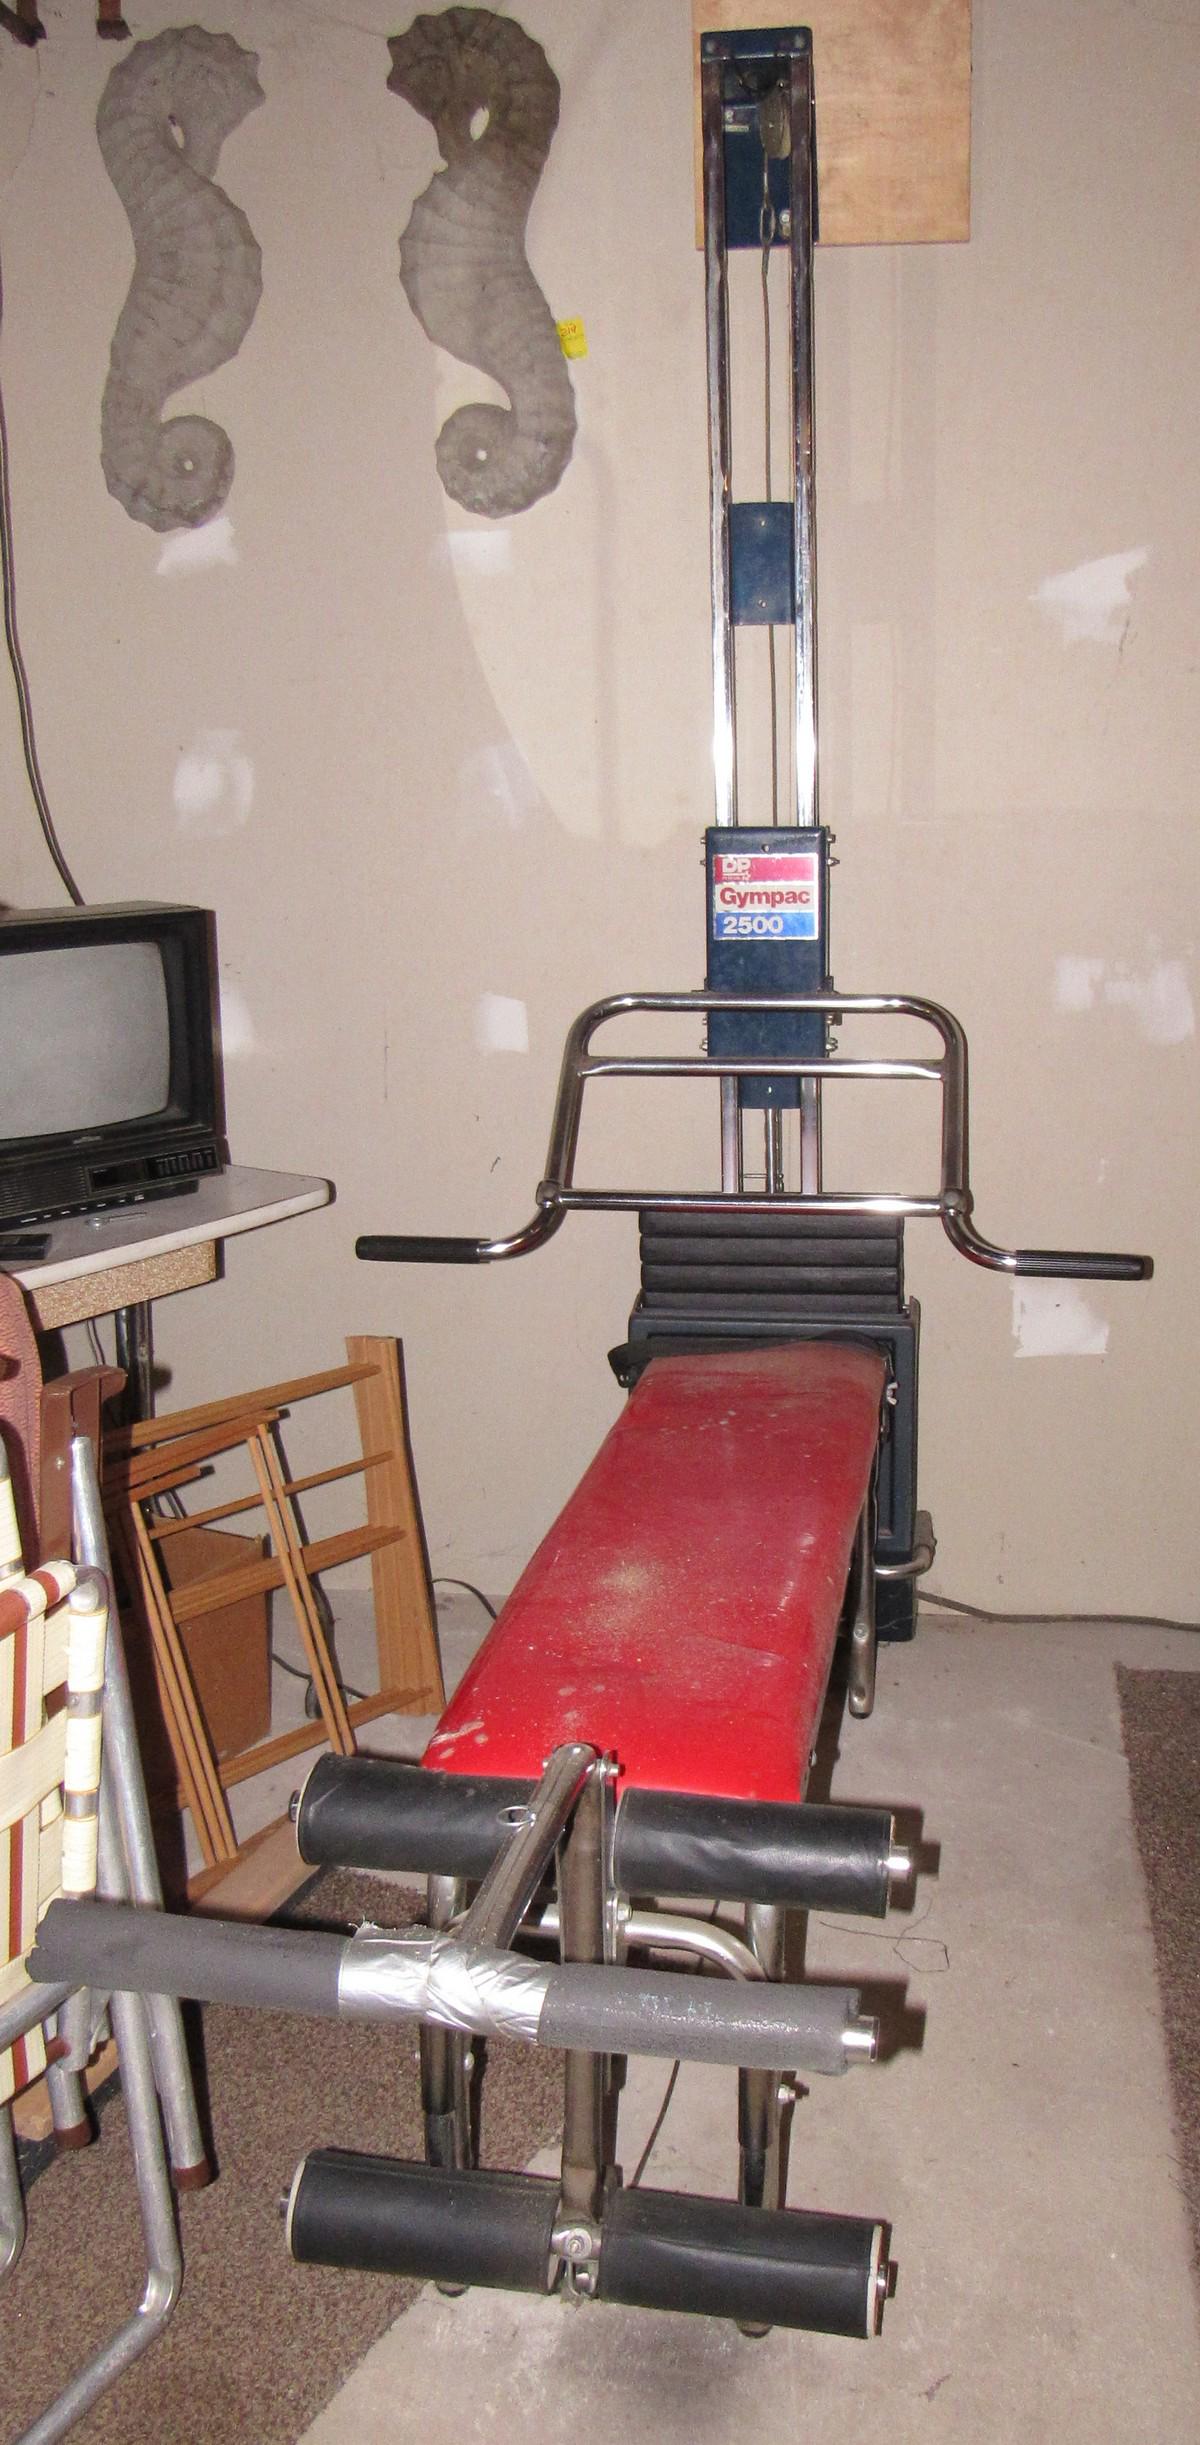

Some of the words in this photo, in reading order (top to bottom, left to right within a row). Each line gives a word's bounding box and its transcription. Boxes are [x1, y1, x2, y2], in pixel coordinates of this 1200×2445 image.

[722, 857, 752, 873] DP
[719, 887, 811, 909] Gympac
[723, 916, 784, 935] 2500
